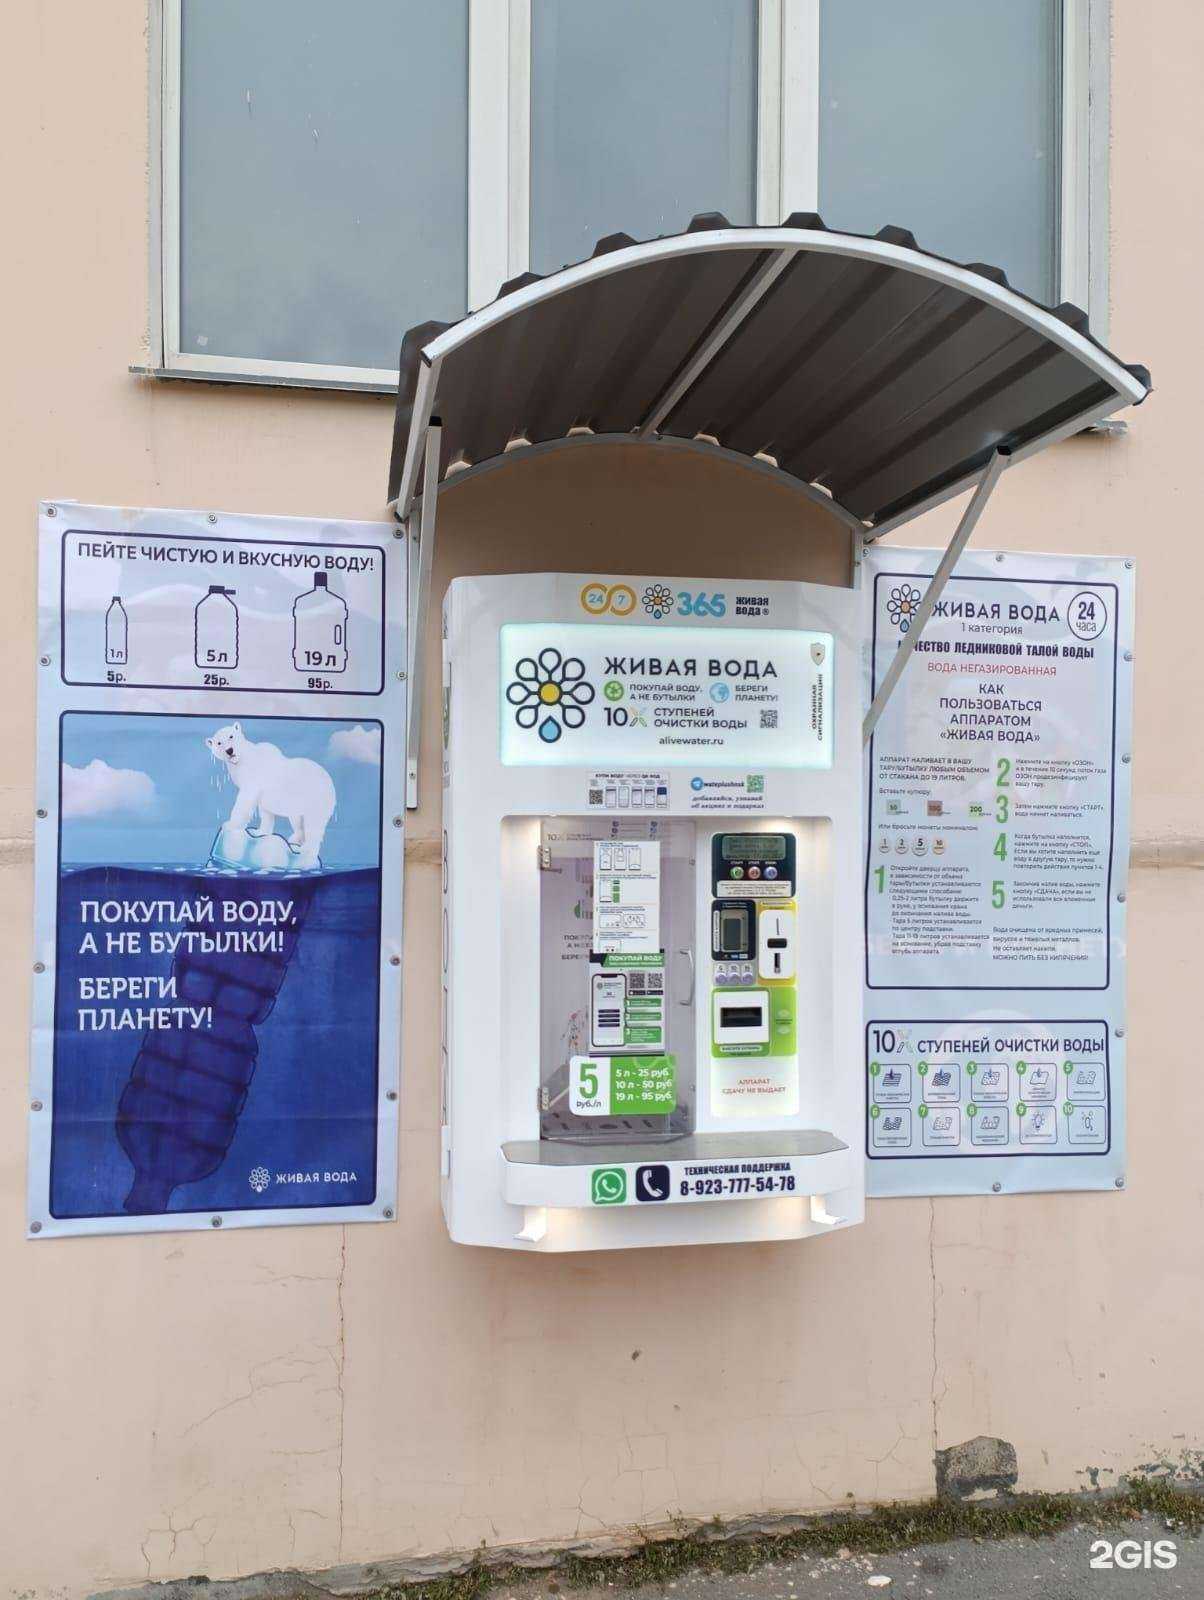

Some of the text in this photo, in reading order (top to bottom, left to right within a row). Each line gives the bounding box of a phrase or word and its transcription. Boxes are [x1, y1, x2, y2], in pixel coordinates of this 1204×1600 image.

[78, 542, 374, 572] ПЕЙТЕ ЧИСТУЮ И ВКУСНУЮ ВОДУ!
[589, 594, 603, 603] 24
[677, 592, 726, 617] 365
[932, 602, 1060, 624] ЖИВАЯ ВОДА
[1078, 602, 1095, 620] 24
[969, 625, 1023, 636] категория
[1076, 623, 1096, 632] часа
[954, 642, 1022, 655] ЛЕДНИКОВОЙ
[1027, 644, 1058, 657] ТАЛОЙ
[1063, 646, 1094, 659] ВОДЫ
[604, 656, 778, 680] ЖИВАЯ ВОДА
[928, 662, 1056, 676] ВОДА НЕГАЗИРОВАННАЯ
[107, 670, 126, 682] 5р.
[204, 674, 230, 687] 25р.
[308, 678, 333, 691] 95р.
[630, 683, 673, 691] ПОКУПАЙ
[979, 684, 1004, 694] КАК
[654, 706, 714, 717] СТУПЕНЕЙ
[940, 698, 1041, 711] ПОЛЬЗОВАТЬСЯ
[654, 719, 747, 729] ОЧИСТКИ ВОДЫ
[950, 714, 1030, 726] АППАРАТОМ
[659, 736, 724, 746] alivewater.ru
[940, 729, 1040, 743] «ЖИВАЯ ВОДА»
[996, 758, 1010, 787] 2
[996, 795, 1008, 823] 3
[994, 833, 1007, 861] 4
[874, 865, 884, 893] 1
[992, 880, 1005, 909] 5
[80, 896, 297, 926] ПОКУПАЙ ВОДУ,
[79, 931, 284, 954] А НЕ БУТЫЛКИ!
[79, 977, 177, 1000] БЕРЕГИ
[78, 1007, 212, 1031] ПЛАНЕТУ!
[917, 1037, 989, 1053] СТУПЕНЕЙ
[995, 1039, 1059, 1052] ОЧИСТКИ
[1063, 1039, 1104, 1052] ВОДЫ
[616, 1069, 622, 1077] 5
[580, 1064, 598, 1098] 5
[684, 1162, 791, 1175] ТЕХНИЧЕСКАЯ ПОДДЕРЖКА
[276, 1171, 357, 1184] ЖИВАЯ ВОДА
[680, 1175, 795, 1196] 8-923-777-54-78
